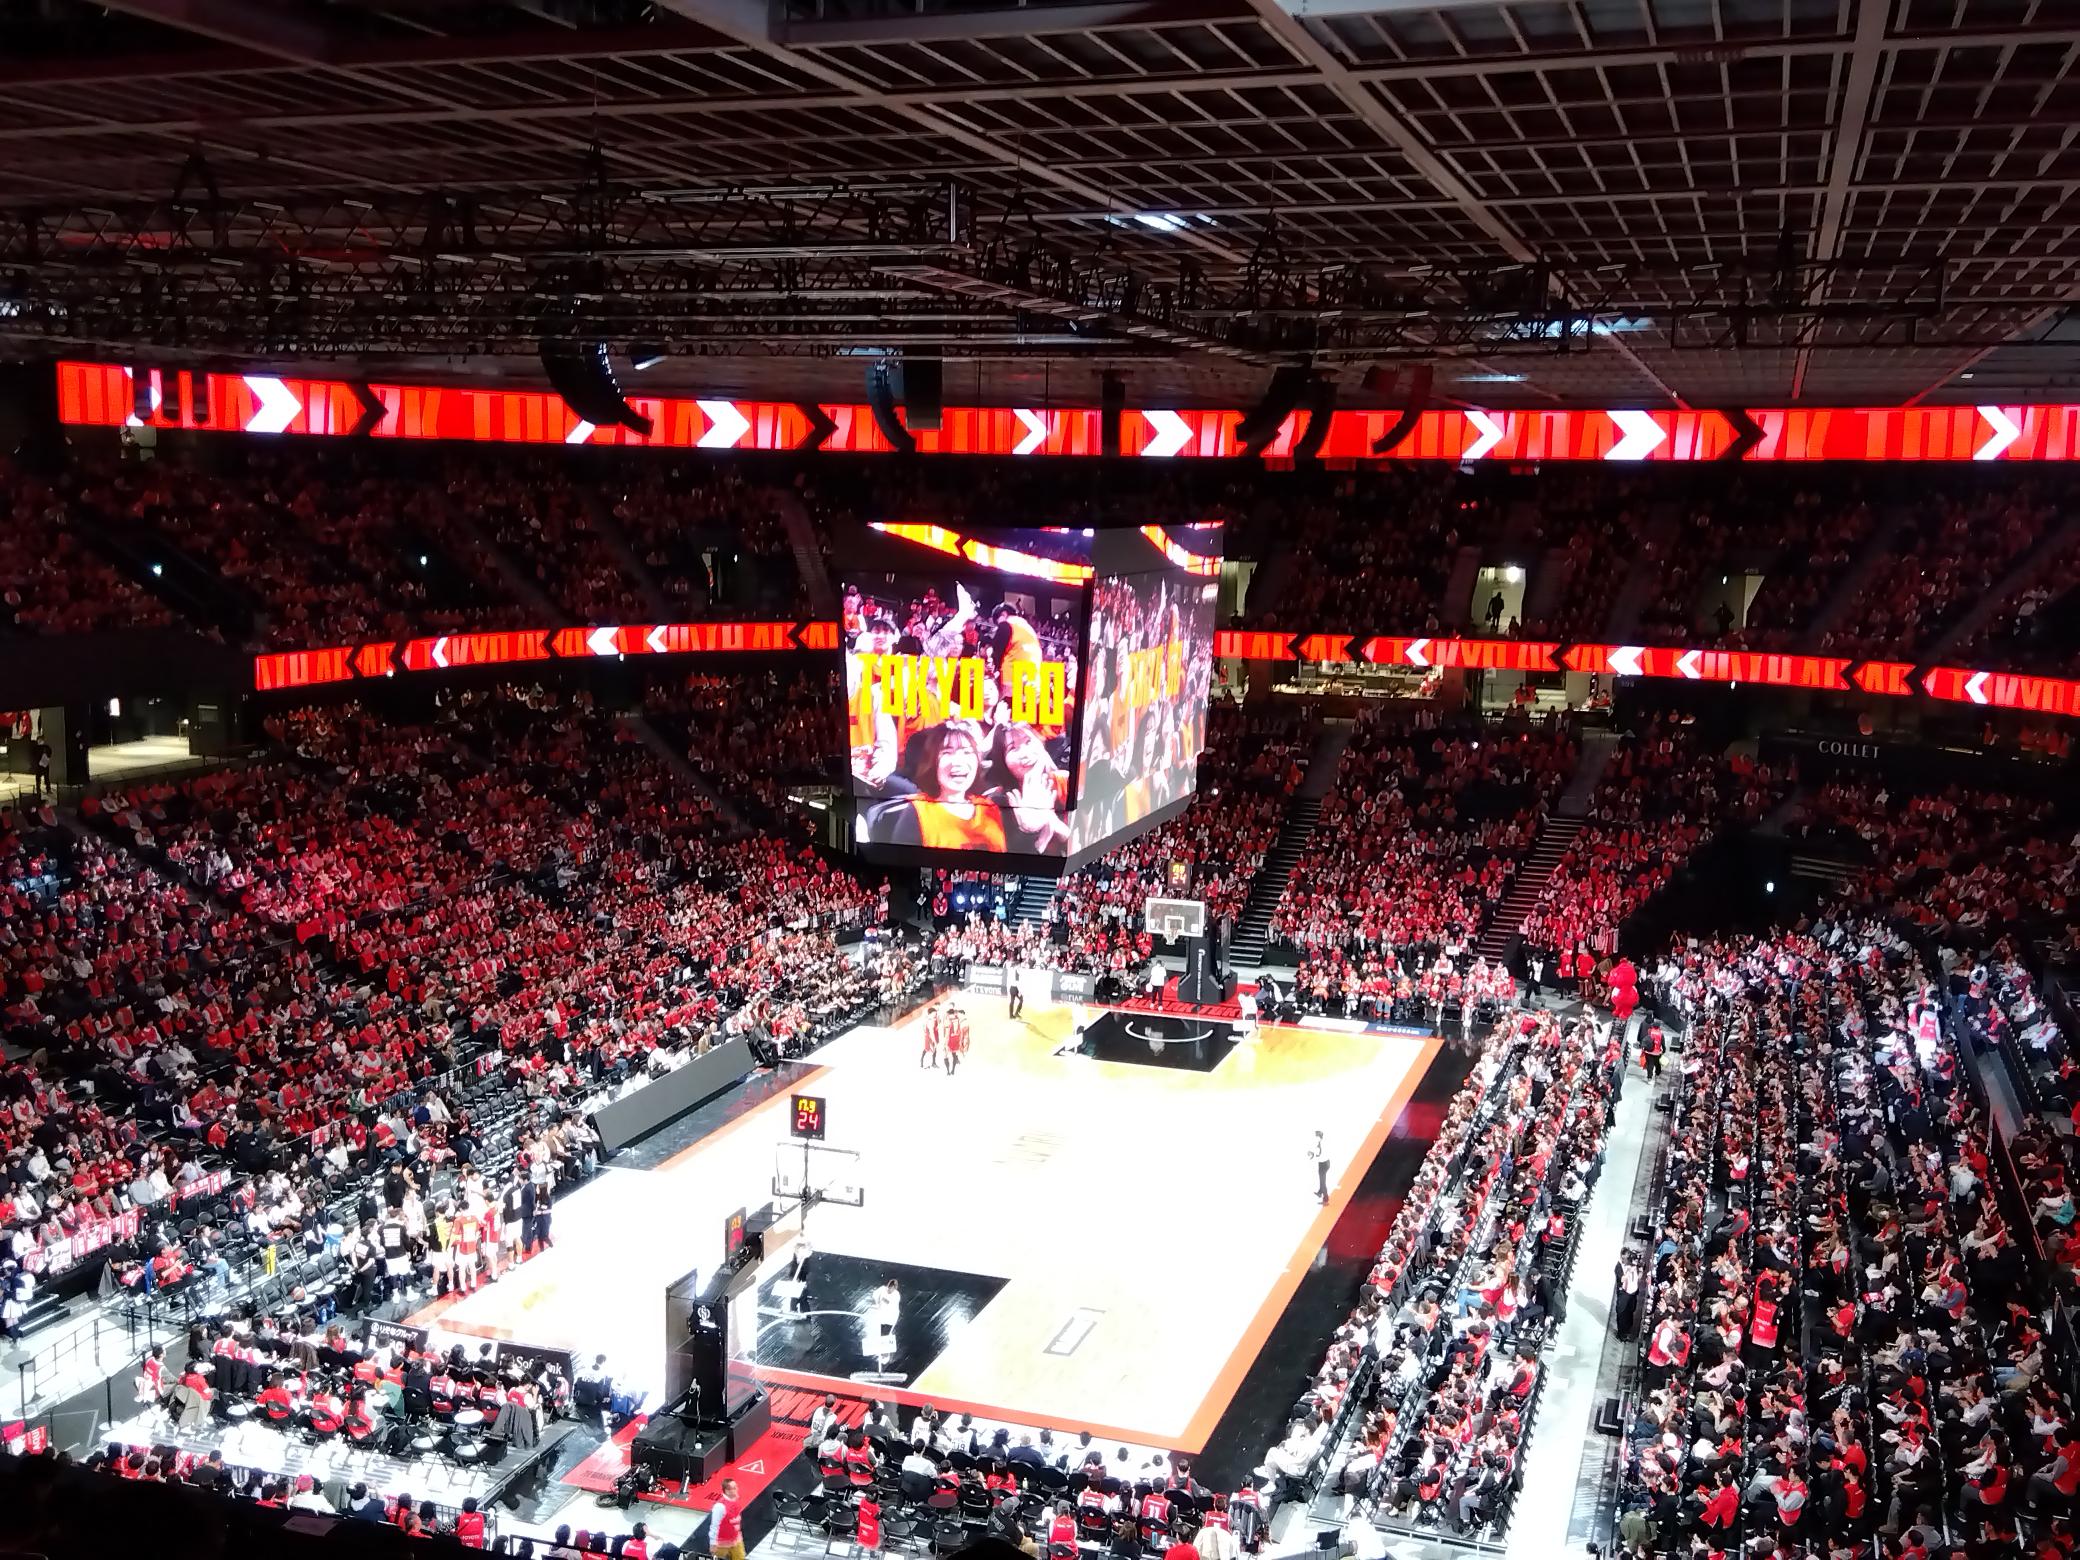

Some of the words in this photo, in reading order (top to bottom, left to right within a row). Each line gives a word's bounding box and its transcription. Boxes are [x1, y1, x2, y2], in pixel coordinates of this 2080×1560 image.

[857, 652, 985, 721] TOKYO
[1011, 660, 1065, 726] GO
[1818, 740, 1880, 758] COLLET
[797, 1111, 819, 1130] 24
